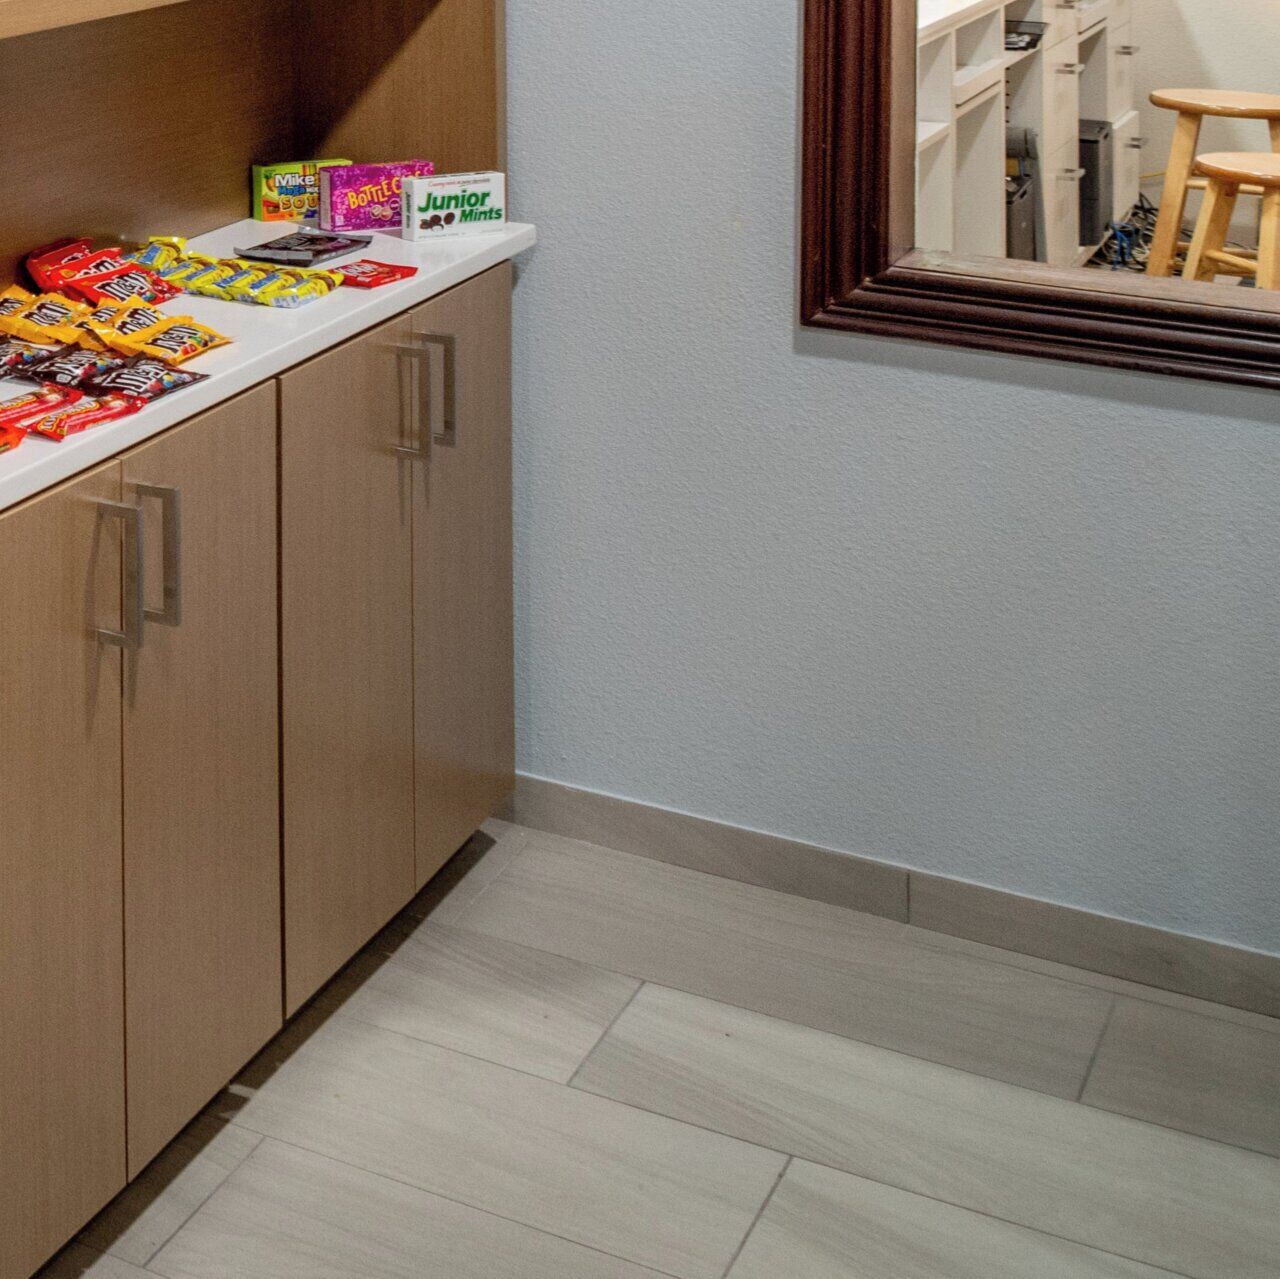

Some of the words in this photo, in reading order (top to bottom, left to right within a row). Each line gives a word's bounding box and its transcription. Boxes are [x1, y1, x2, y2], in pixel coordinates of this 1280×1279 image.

[275, 174, 314, 187] Mike
[348, 183, 391, 209] BOTTLE
[418, 190, 490, 213] Junior
[459, 207, 502, 223] Mints
